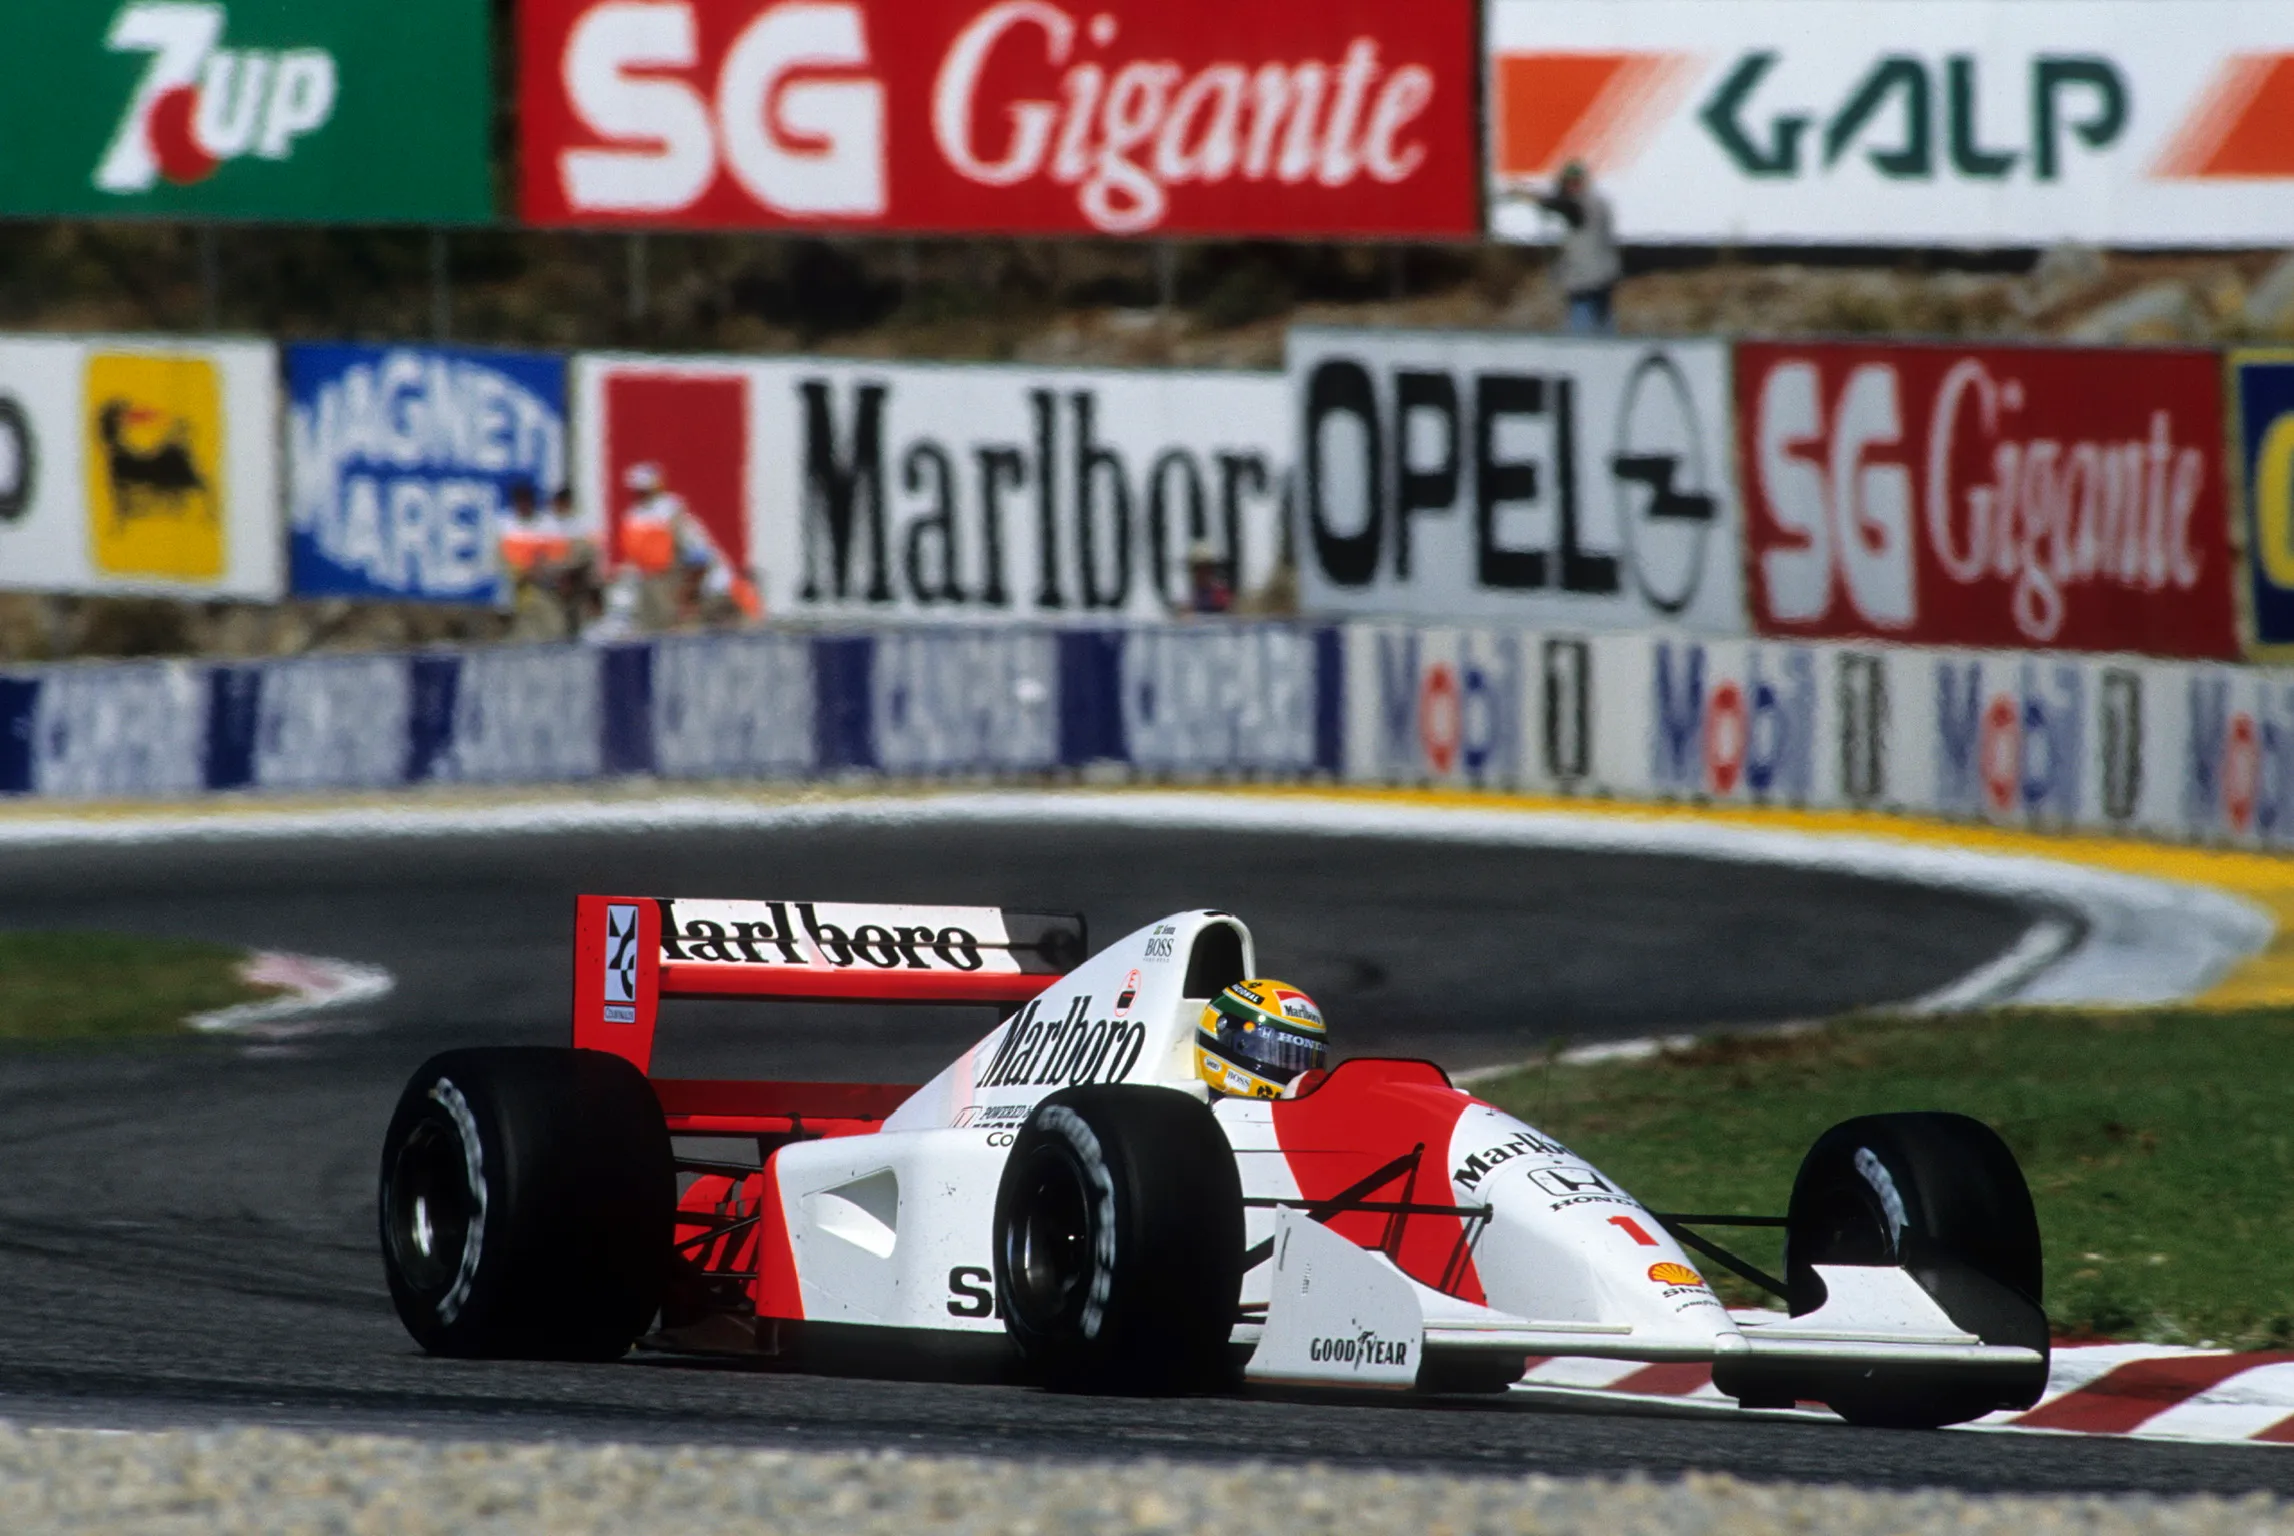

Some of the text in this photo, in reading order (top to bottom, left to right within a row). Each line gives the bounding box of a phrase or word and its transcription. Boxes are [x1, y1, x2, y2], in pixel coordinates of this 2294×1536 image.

[94, 3, 338, 192] 7UP
[560, 0, 1433, 233] SG Gigante
[1699, 48, 2131, 181] GALP
[1306, 355, 1620, 595] OPEL
[1756, 360, 1918, 628] SG
[1928, 358, 2204, 642] Gigante
[1145, 938, 1174, 958] BOSS
[975, 995, 1146, 1089] Marlboro
[1277, 1032, 1328, 1052] HOND
[986, 1131, 1014, 1147] Co
[1606, 1216, 1660, 1246] 1
[946, 1266, 1001, 1319] S
